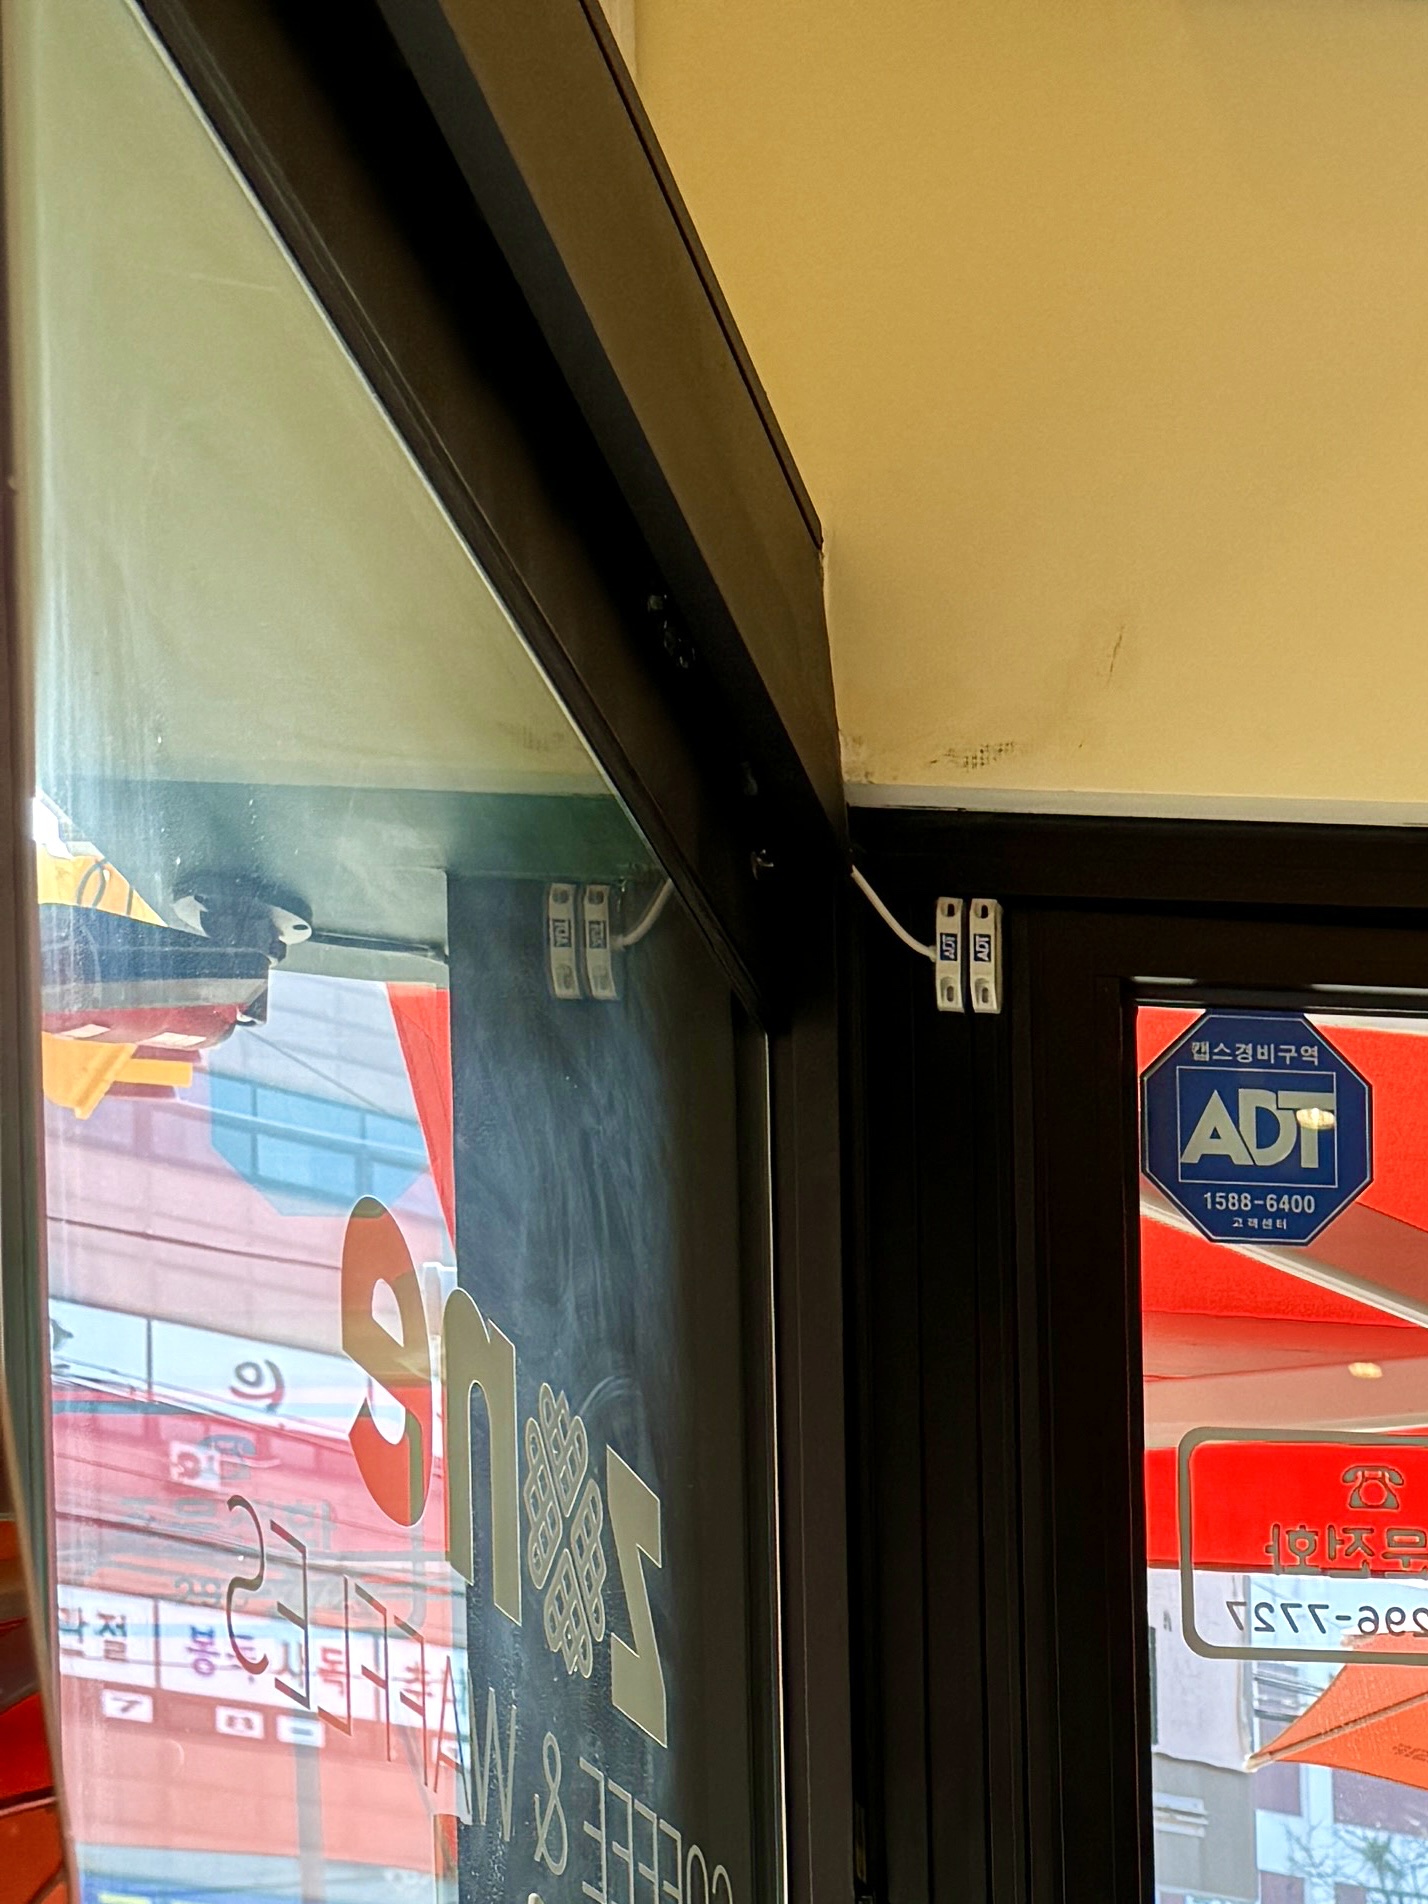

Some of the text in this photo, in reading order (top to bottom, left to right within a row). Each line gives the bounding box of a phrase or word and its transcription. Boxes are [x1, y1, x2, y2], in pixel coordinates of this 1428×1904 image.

[1191, 1041, 1319, 1067] 캡스경비구역
[1181, 1087, 1337, 1170] ADT
[1203, 1191, 1316, 1215] 1588-6400
[1231, 1216, 1288, 1231] 고객센터
